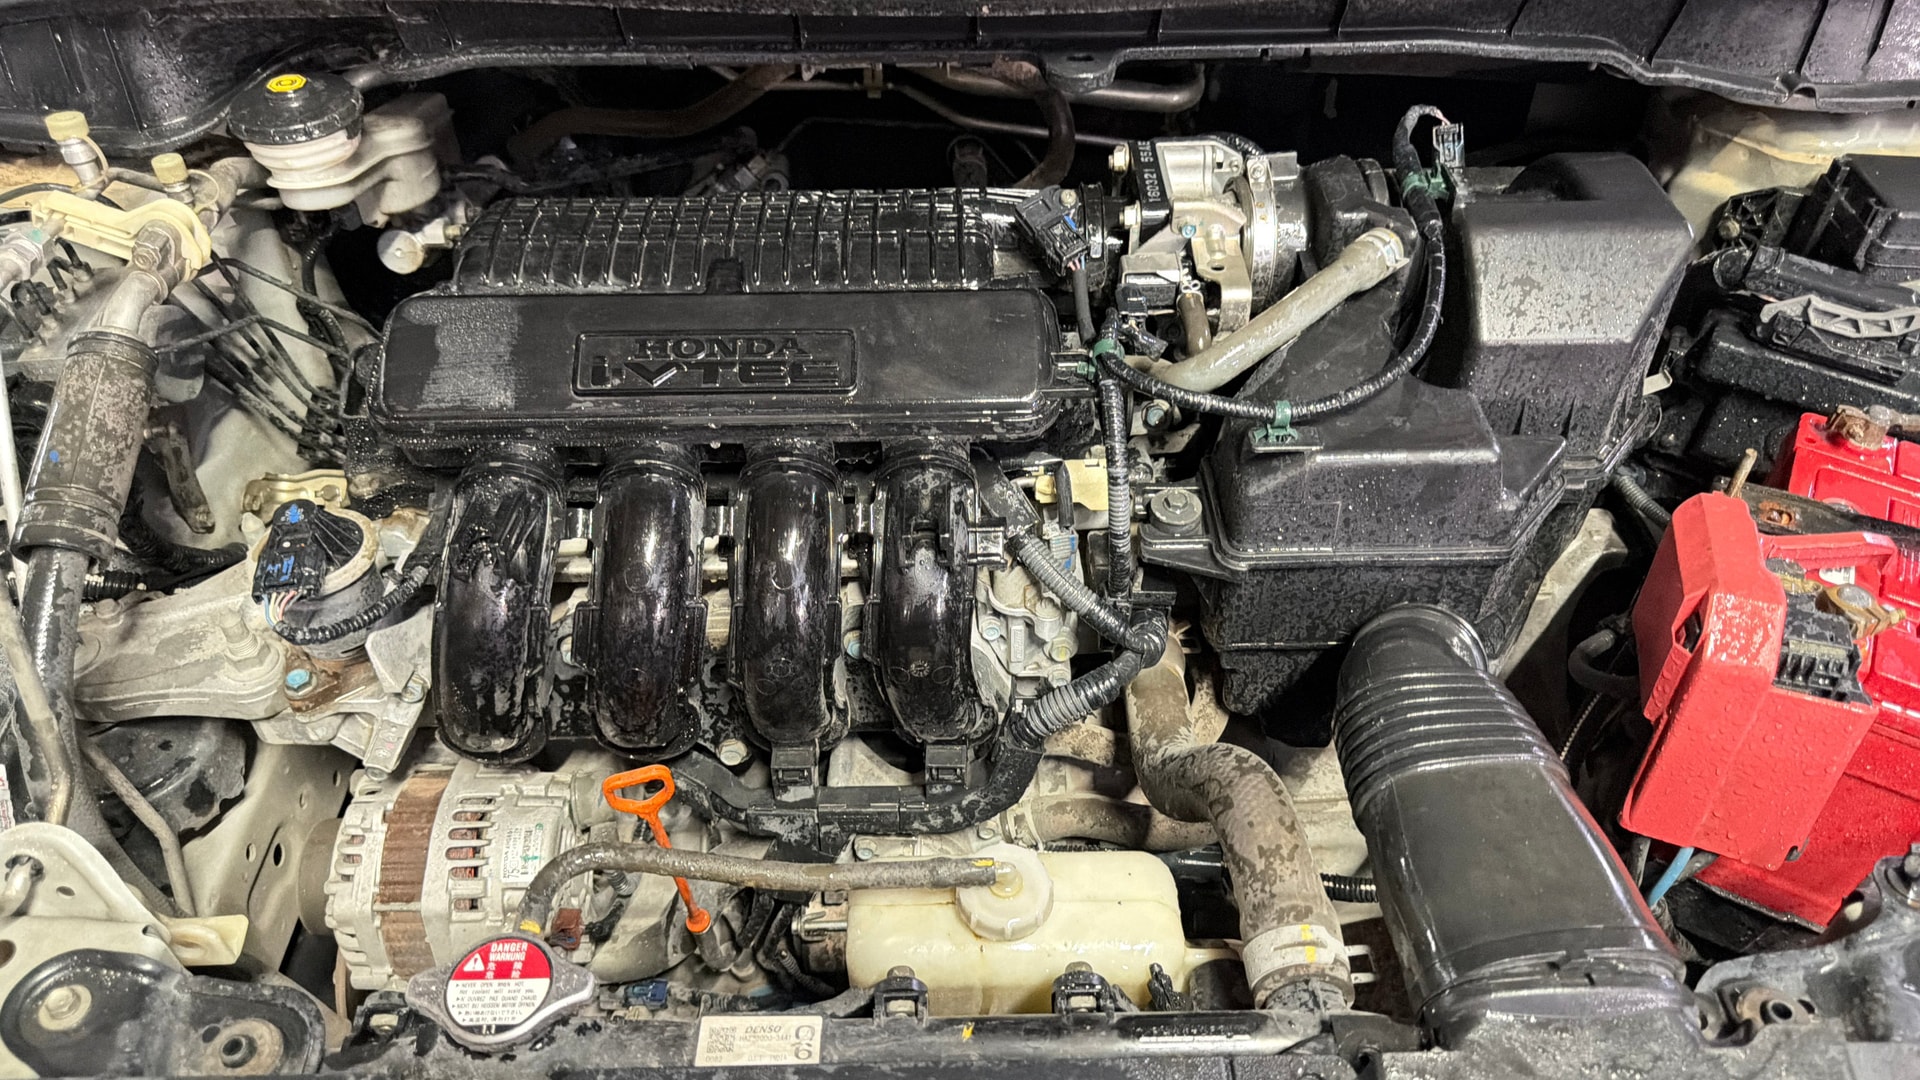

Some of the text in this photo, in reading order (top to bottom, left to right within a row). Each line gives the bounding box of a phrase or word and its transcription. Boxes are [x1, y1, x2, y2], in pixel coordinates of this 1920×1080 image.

[1137, 140, 1161, 202] 160321 55AE
[631, 337, 813, 360] HONDA
[491, 942, 528, 952] DANGER
[489, 952, 526, 961] WARNUNG
[745, 1025, 782, 1034] DENSO
